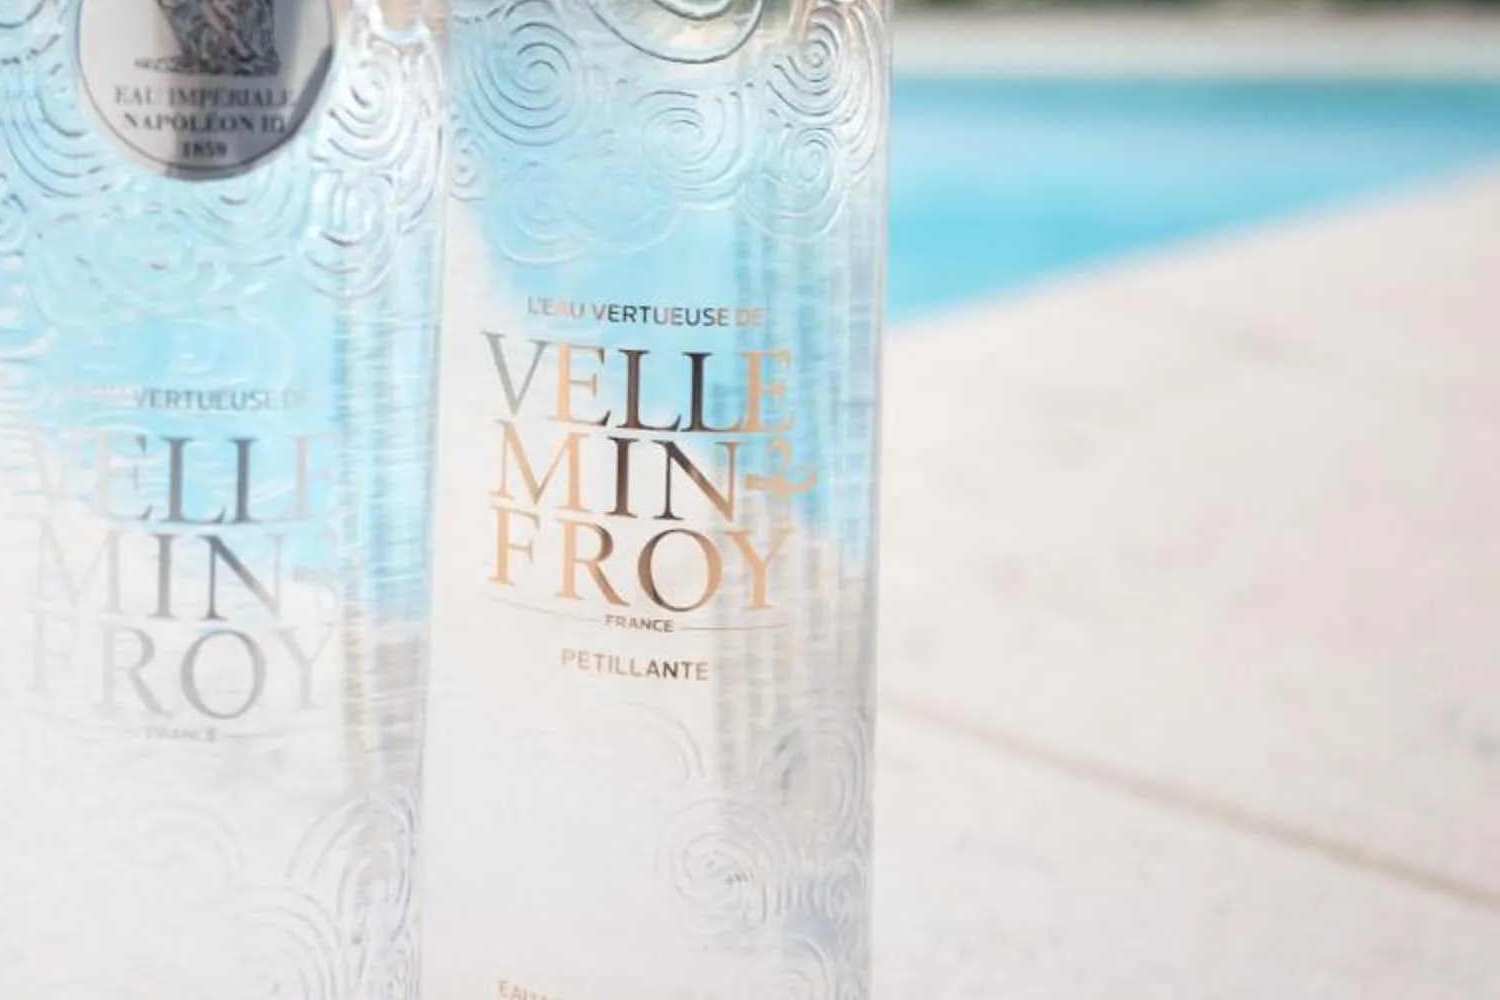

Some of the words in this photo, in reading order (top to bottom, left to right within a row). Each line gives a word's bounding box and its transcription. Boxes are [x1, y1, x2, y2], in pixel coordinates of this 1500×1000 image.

[115, 84, 156, 106] EAU
[123, 111, 254, 133] NAPOLÉON
[182, 140, 229, 158] 1859
[527, 296, 586, 319] L'EAU
[591, 300, 730, 327] VERTUEUSE
[735, 305, 766, 327] DE
[480, 331, 794, 433] VELLE
[133, 386, 276, 412] VERTUEUSE
[487, 503, 794, 614] FROY
[605, 614, 675, 633] FRANCE
[23, 606, 336, 721] FROY
[561, 647, 709, 681] PETILLANTE
